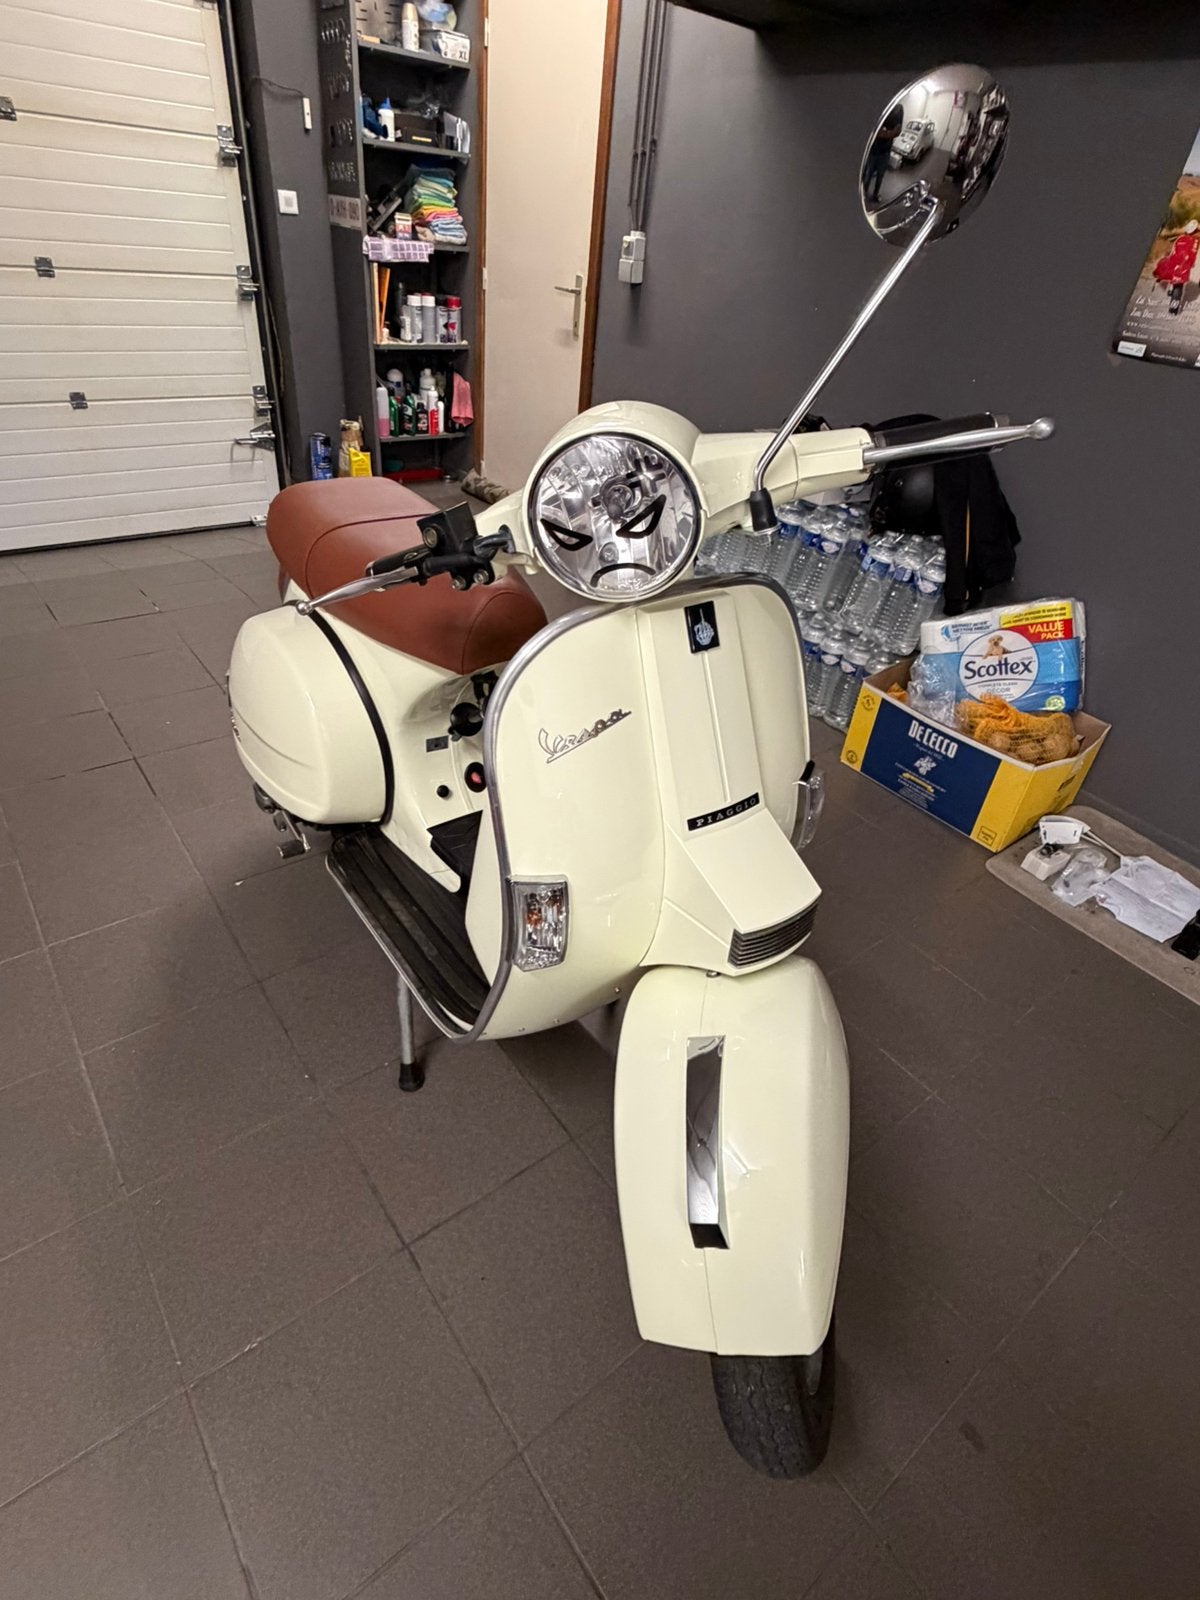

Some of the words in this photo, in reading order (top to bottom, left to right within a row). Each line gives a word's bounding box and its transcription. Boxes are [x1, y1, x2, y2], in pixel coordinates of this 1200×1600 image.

[458, 50, 468, 61] XL
[1028, 621, 1065, 632] VALUE
[1040, 631, 1065, 640] PACK
[964, 657, 1033, 680] Scottex
[538, 708, 632, 764] Vespa
[695, 796, 757, 828] PIAGGIO
